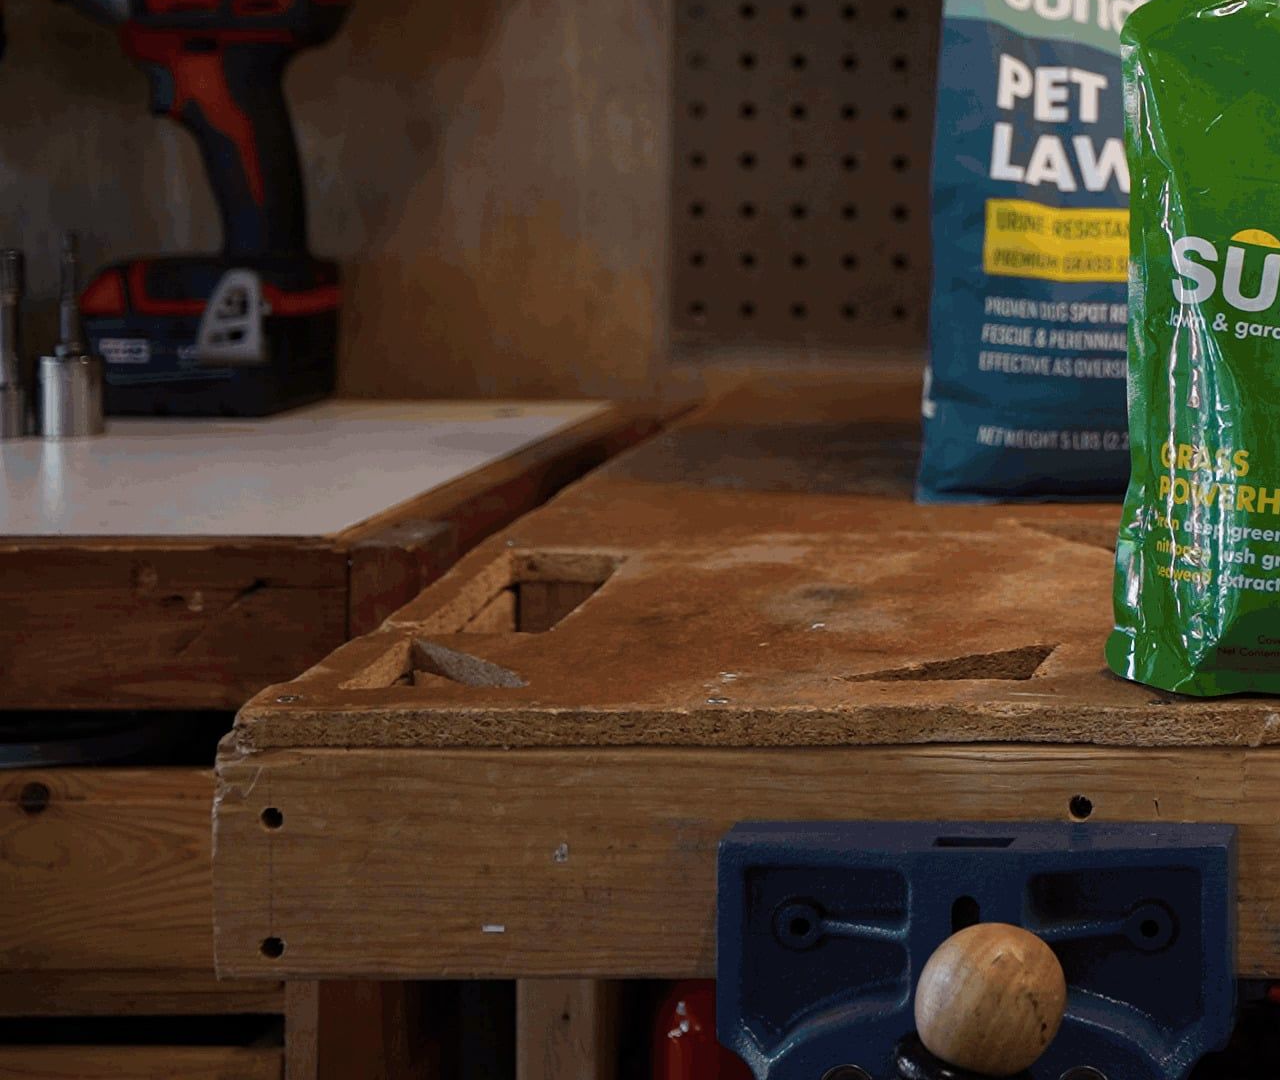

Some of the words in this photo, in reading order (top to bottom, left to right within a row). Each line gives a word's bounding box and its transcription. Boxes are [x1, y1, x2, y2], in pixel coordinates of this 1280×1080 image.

[996, 53, 1109, 124] PET
[1051, 218, 1130, 241] RESISTA
[984, 295, 1038, 320] PROVEN
[1069, 302, 1107, 324] SPOT
[1212, 313, 1228, 331] &
[981, 323, 1033, 347] FESCUE
[1034, 327, 1047, 348] &
[978, 350, 1051, 376] EFFECTIVE
[1053, 357, 1073, 378] AS
[977, 425, 1003, 447] NET
[1004, 427, 1058, 450] WEIGHT
[1059, 430, 1071, 450] 5
[1072, 430, 1101, 451] LBS
[1160, 442, 1250, 476] GRASS
